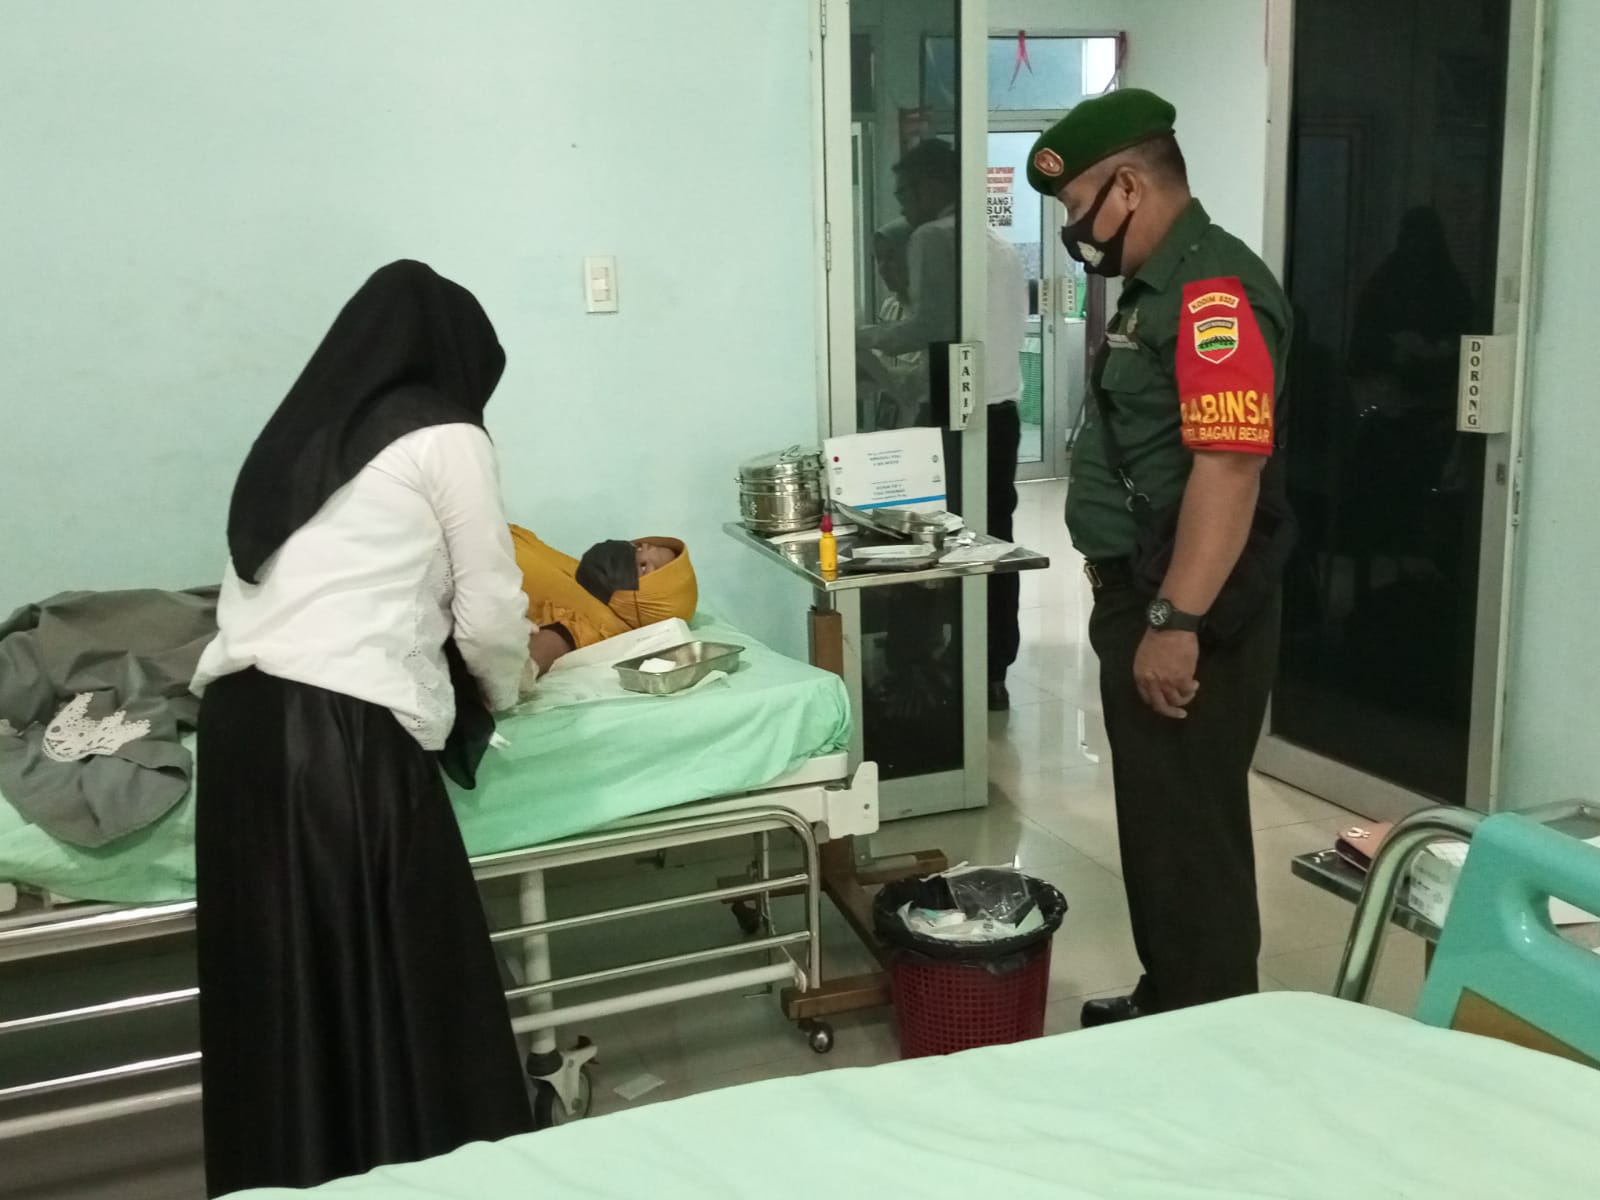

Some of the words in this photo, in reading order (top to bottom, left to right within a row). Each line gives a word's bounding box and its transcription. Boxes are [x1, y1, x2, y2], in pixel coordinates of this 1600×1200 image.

[986, 206, 1012, 215] SUK
[1468, 341, 1481, 425] DORONG
[1200, 425, 1238, 442] BAGAN
[1239, 426, 1272, 444] BESAR
